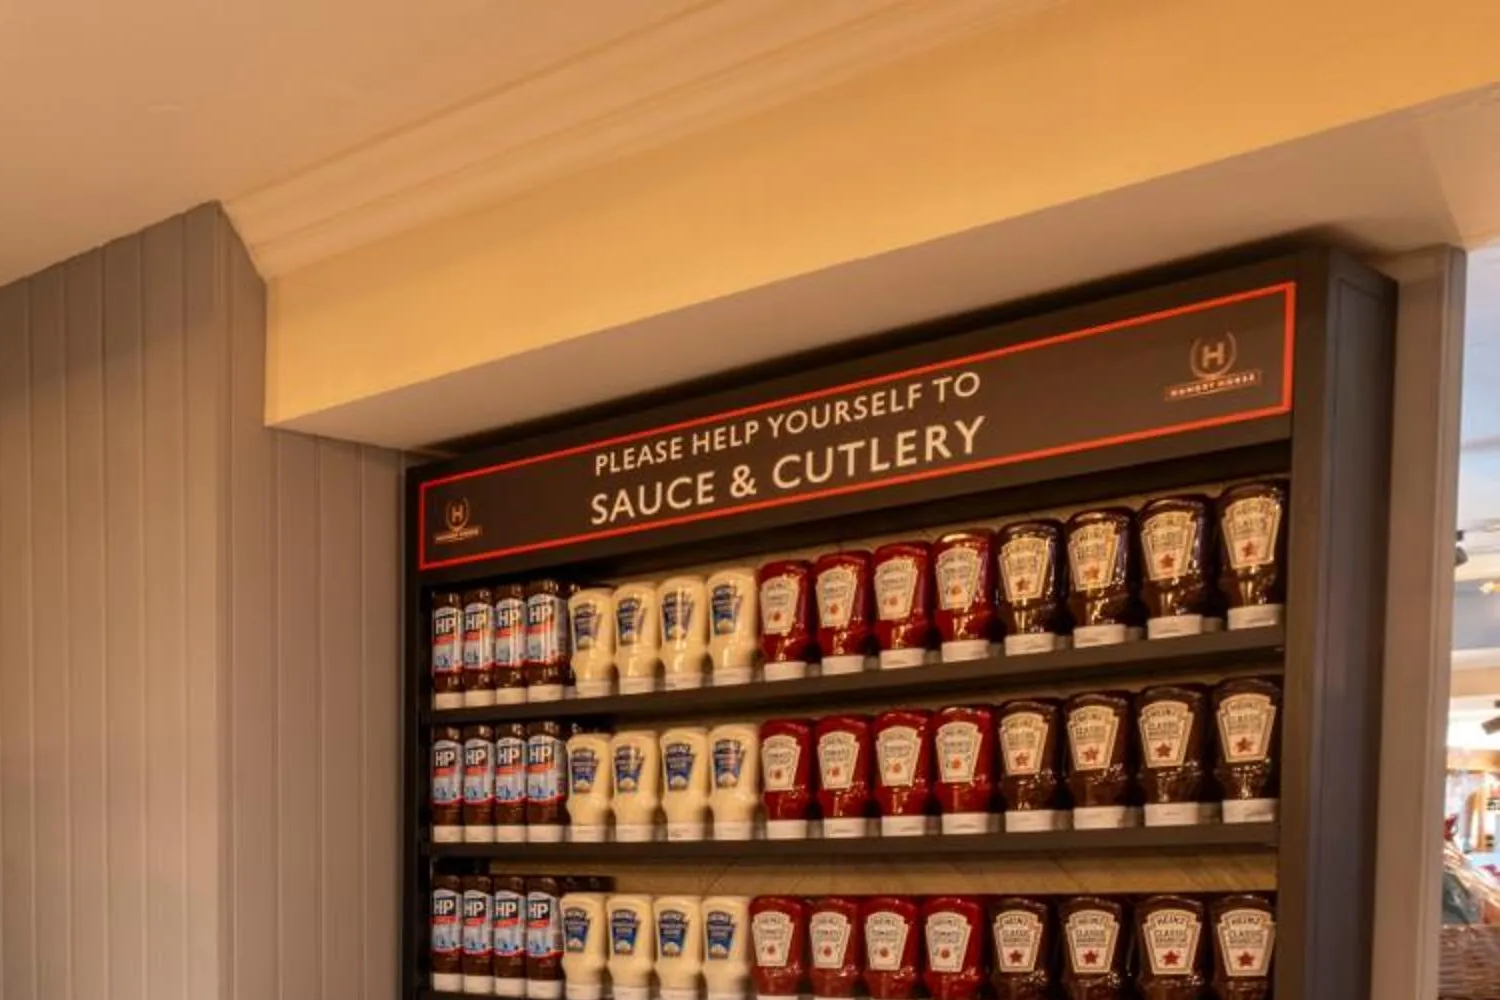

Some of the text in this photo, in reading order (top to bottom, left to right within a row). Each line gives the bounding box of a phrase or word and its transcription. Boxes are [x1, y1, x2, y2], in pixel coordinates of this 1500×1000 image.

[595, 371, 980, 476] PLEASE HELP YOURSELF TO
[591, 415, 986, 525] SAUCE & CUTLERY
[435, 750, 455, 767] HP
[465, 748, 487, 765] HP
[498, 747, 520, 764] HP
[529, 744, 553, 763] HP
[434, 899, 454, 915] HP
[464, 901, 484, 916] HP
[495, 901, 517, 917] HP
[528, 903, 549, 918] HP
